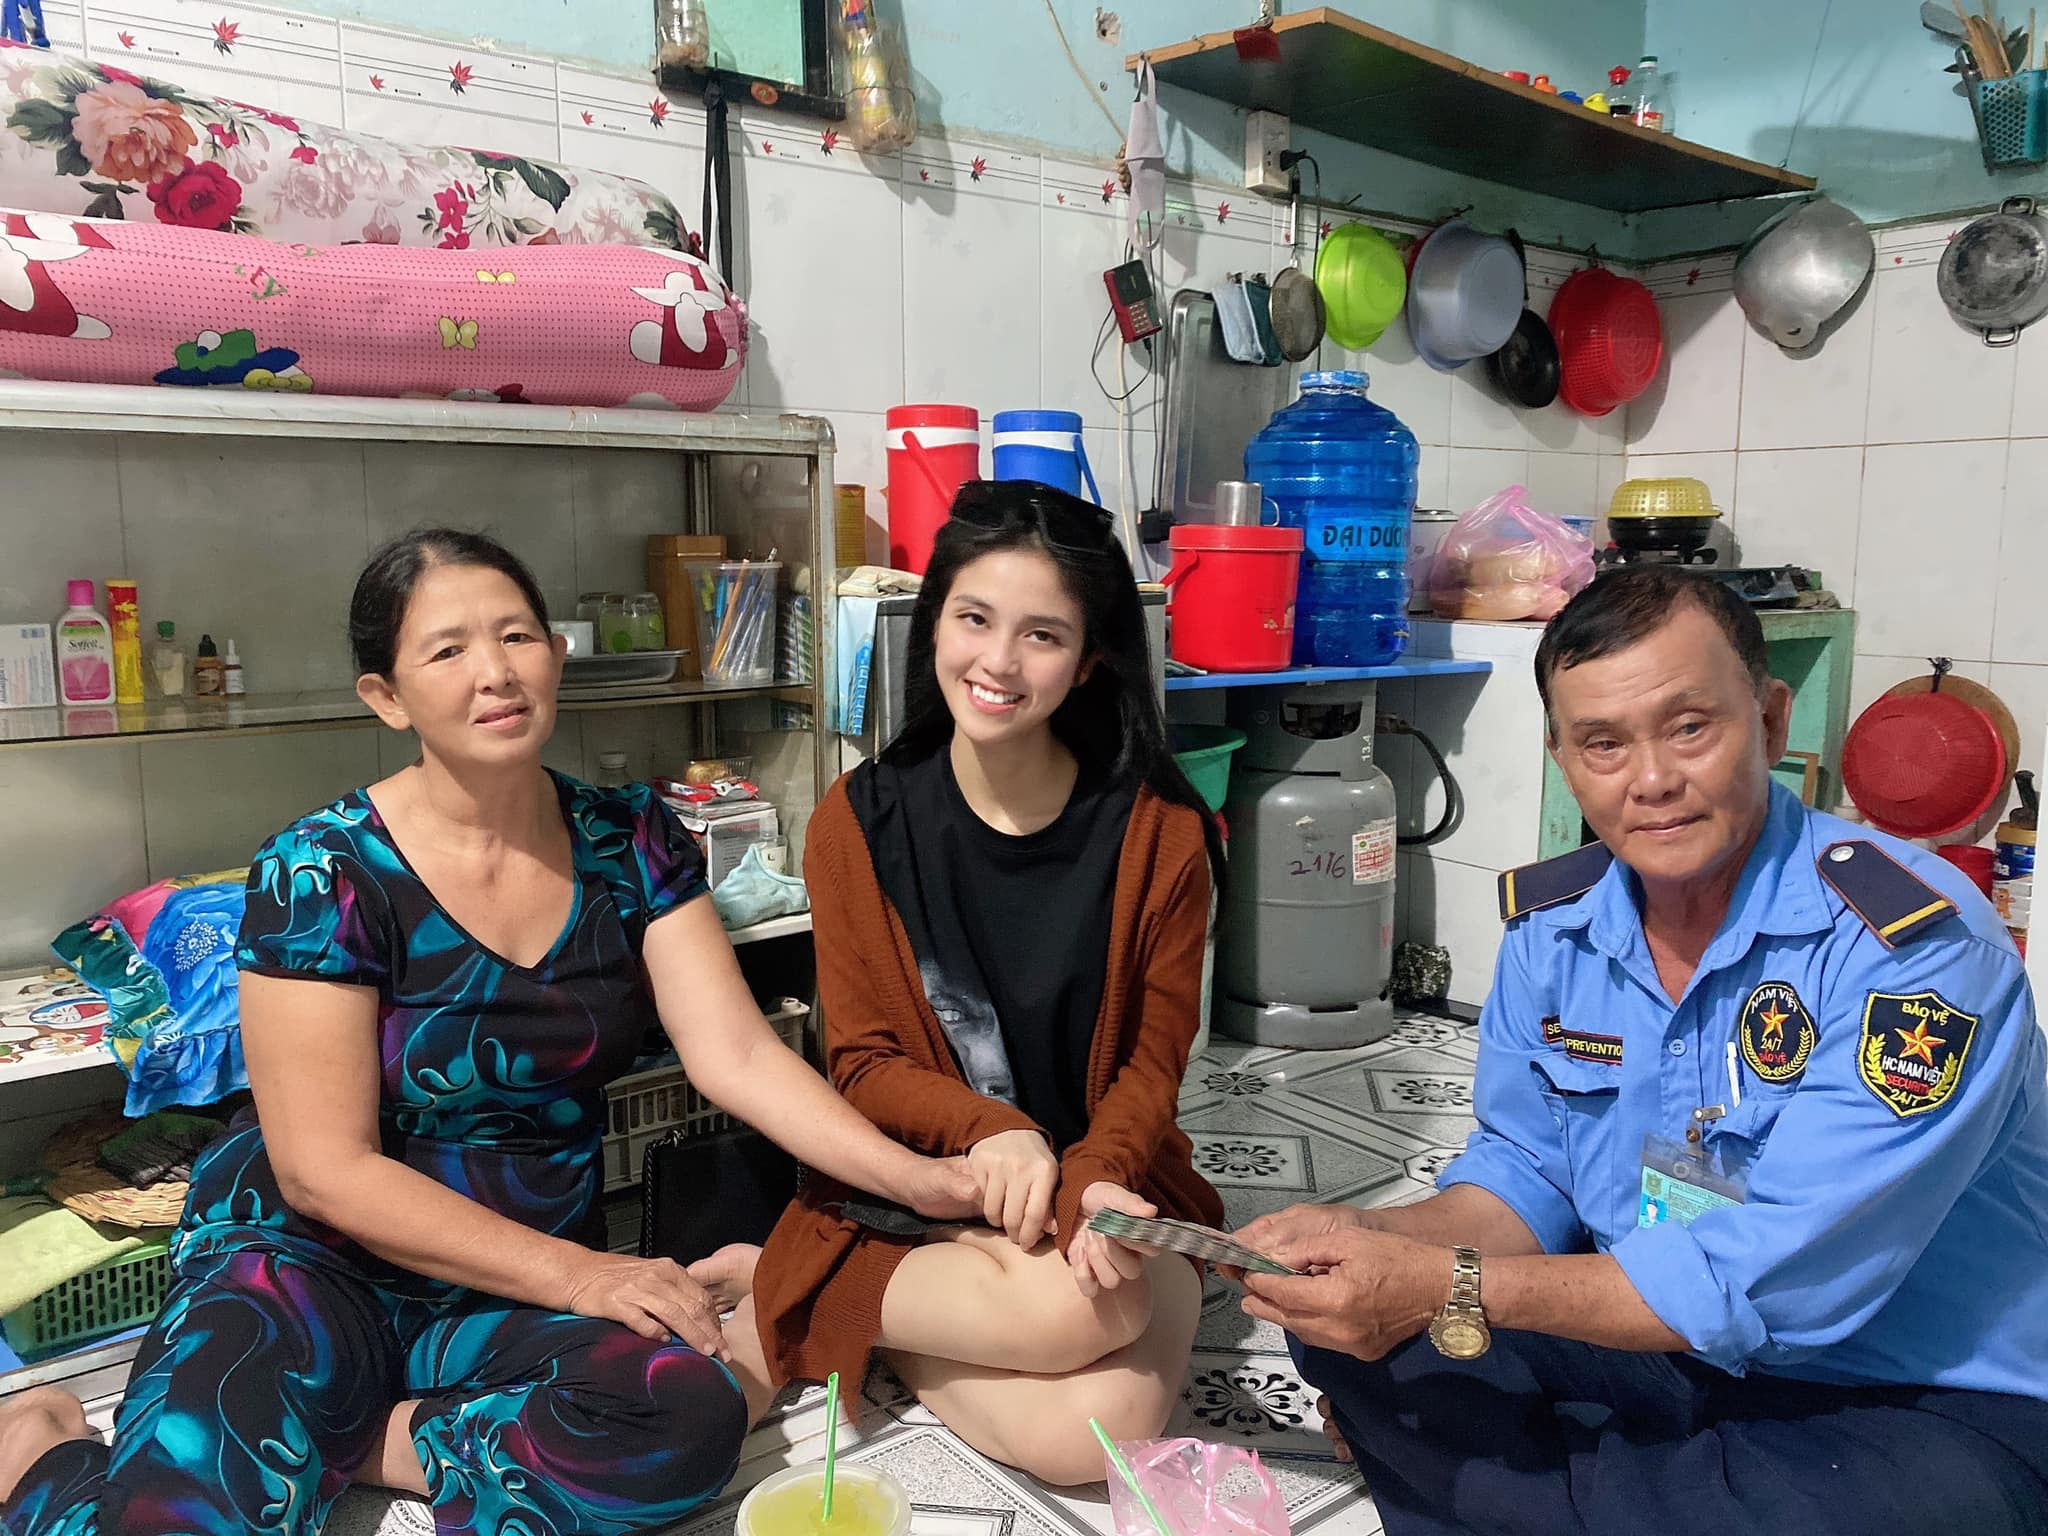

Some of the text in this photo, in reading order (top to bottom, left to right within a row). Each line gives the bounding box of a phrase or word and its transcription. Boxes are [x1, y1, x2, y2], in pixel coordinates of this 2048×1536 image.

[1322, 525, 1362, 552] ĐẠI
[1361, 735, 1371, 762] 13.4
[1752, 988, 1798, 1014] NAM VIỆT
[1902, 1001, 1950, 1026] BẢO VỆ
[1547, 1023, 1561, 1035] SE
[1566, 1038, 1623, 1056] PREVENTIO
[1760, 1039, 1782, 1051] 24/7
[1882, 1055, 1898, 1071] HC
[1898, 1060, 1923, 1079] NAM
[1890, 1088, 1921, 1106] 24/7
